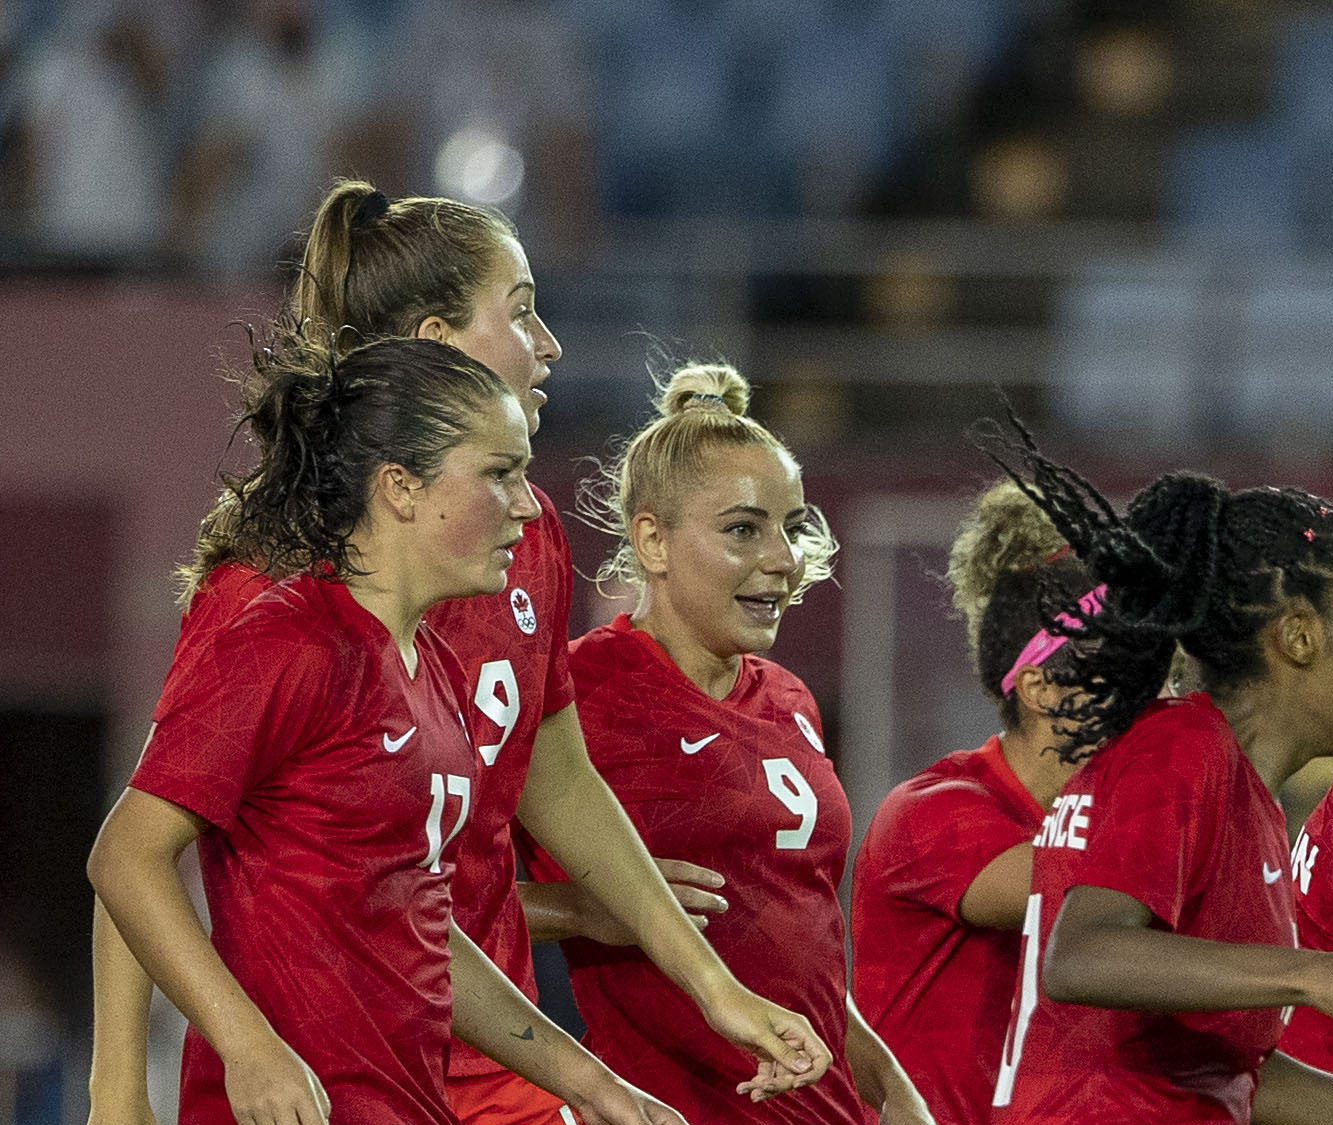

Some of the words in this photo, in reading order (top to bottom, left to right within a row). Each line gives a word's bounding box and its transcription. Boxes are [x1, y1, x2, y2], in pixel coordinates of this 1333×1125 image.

[475, 659, 520, 765] 9
[416, 773, 470, 873] 17
[763, 757, 818, 849] 9
